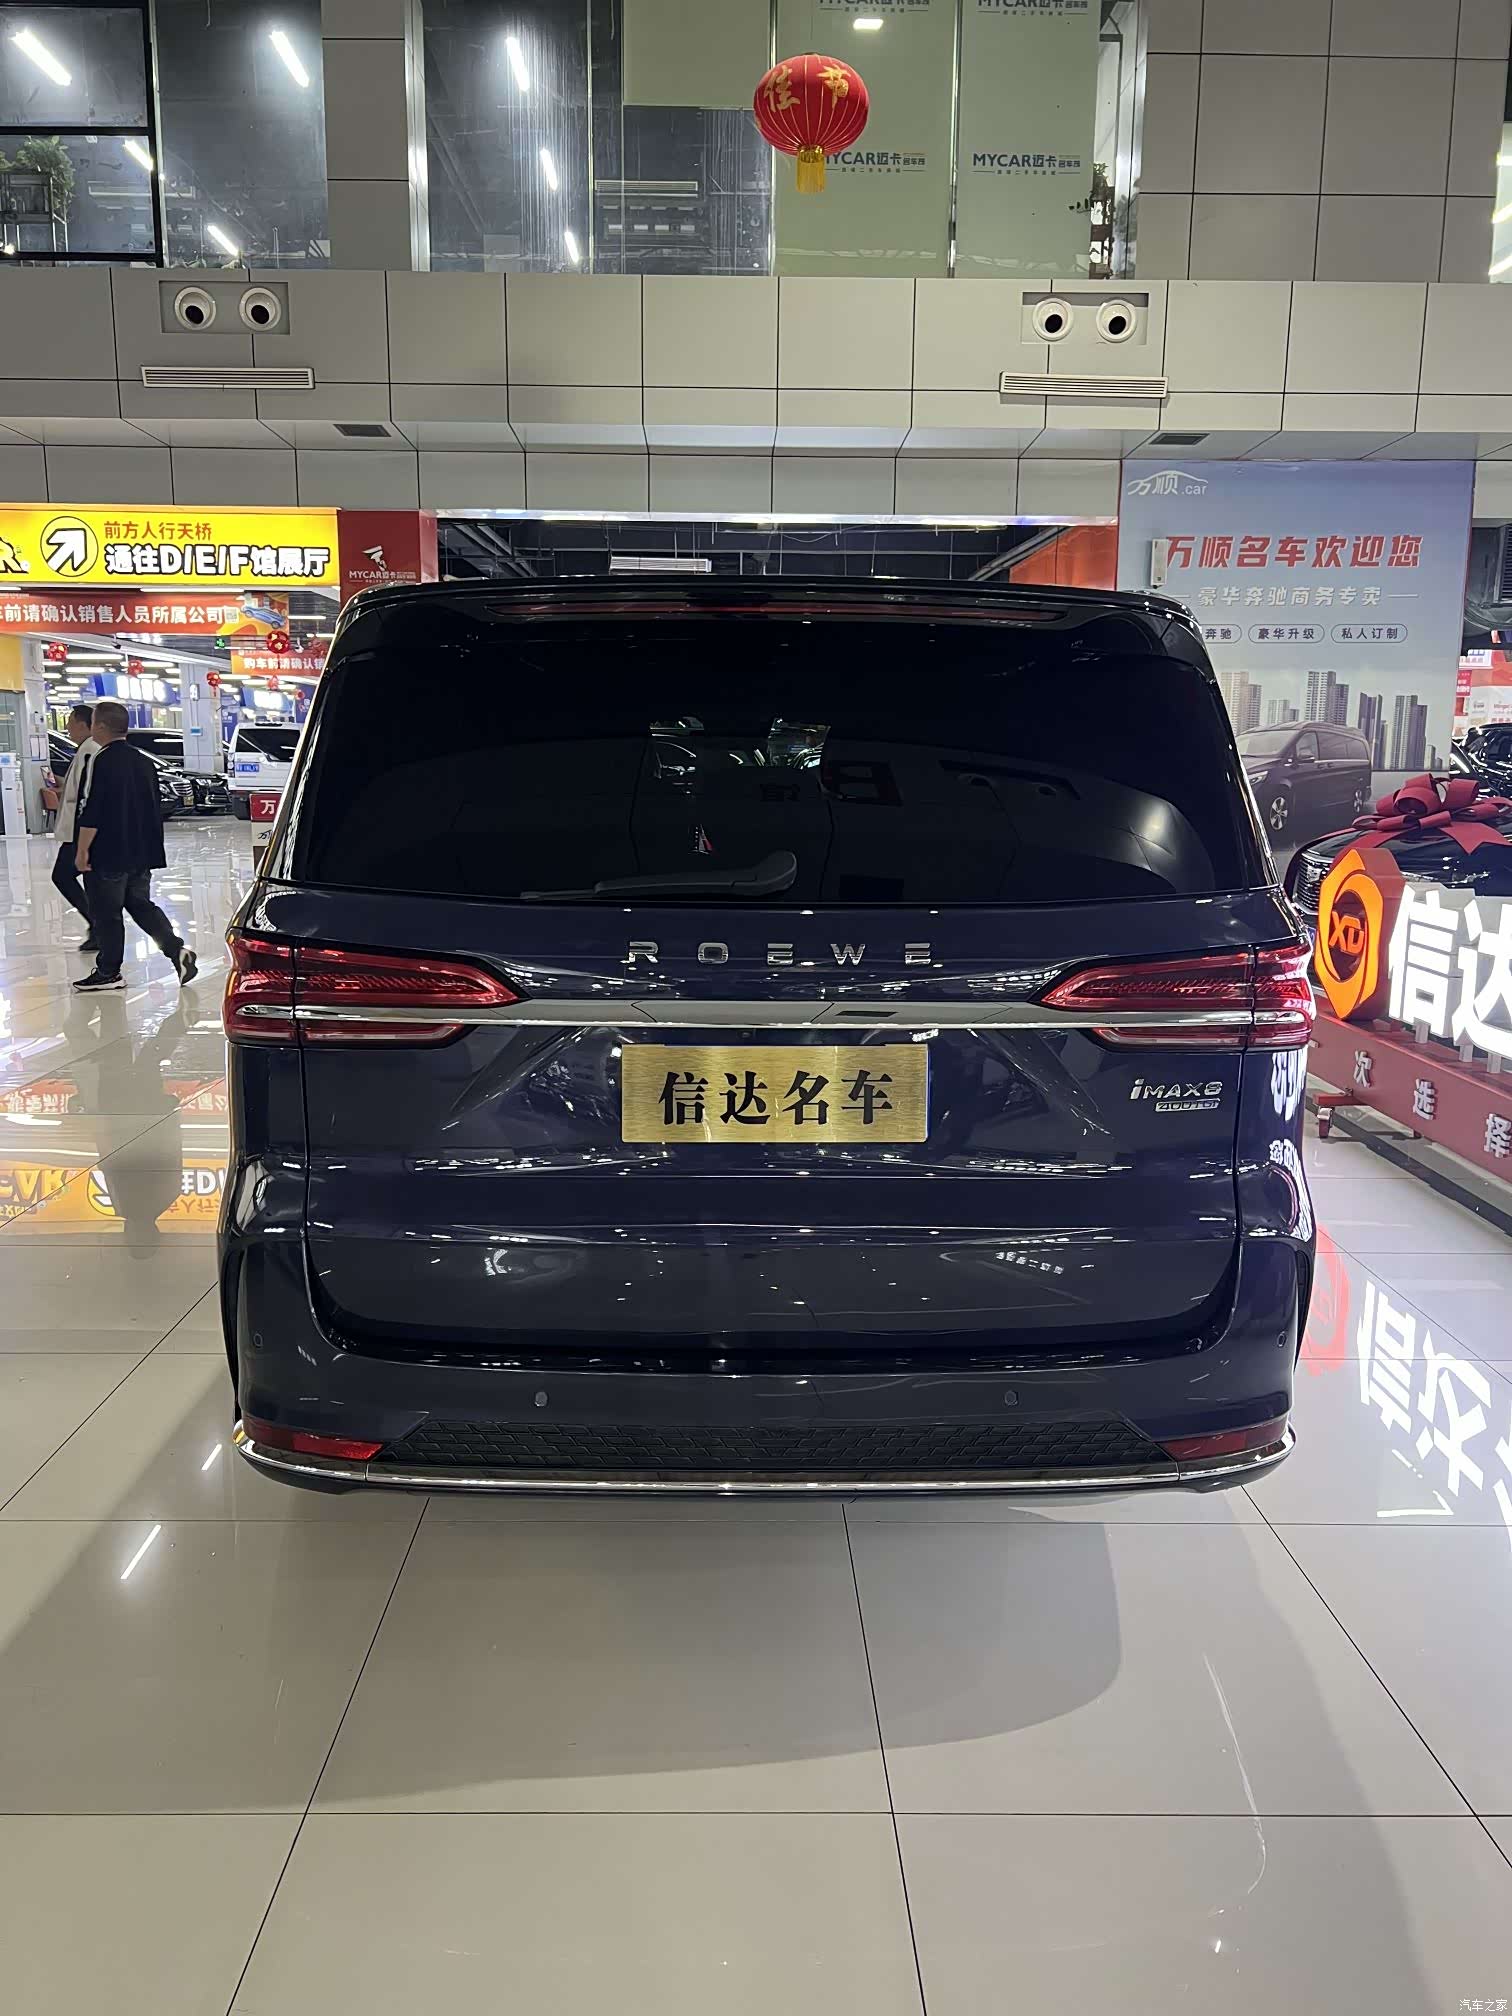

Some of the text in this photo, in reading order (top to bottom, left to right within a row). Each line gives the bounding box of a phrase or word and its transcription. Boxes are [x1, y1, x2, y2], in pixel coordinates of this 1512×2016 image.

[104, 520, 212, 540] 前方人行天桥
[105, 544, 329, 576] 通往D/E/F馆展厅
[1166, 535, 1423, 569] 万顺名车欢迎您
[1198, 587, 1382, 607] 豪华奔驰商务专卖
[0, 603, 224, 624] 前请确认销售人员所属公司
[1257, 627, 1315, 640] 豪华升级
[1341, 627, 1399, 640] 私人订制
[627, 941, 932, 966] ROEWE
[658, 1070, 893, 1126] 信达名车
